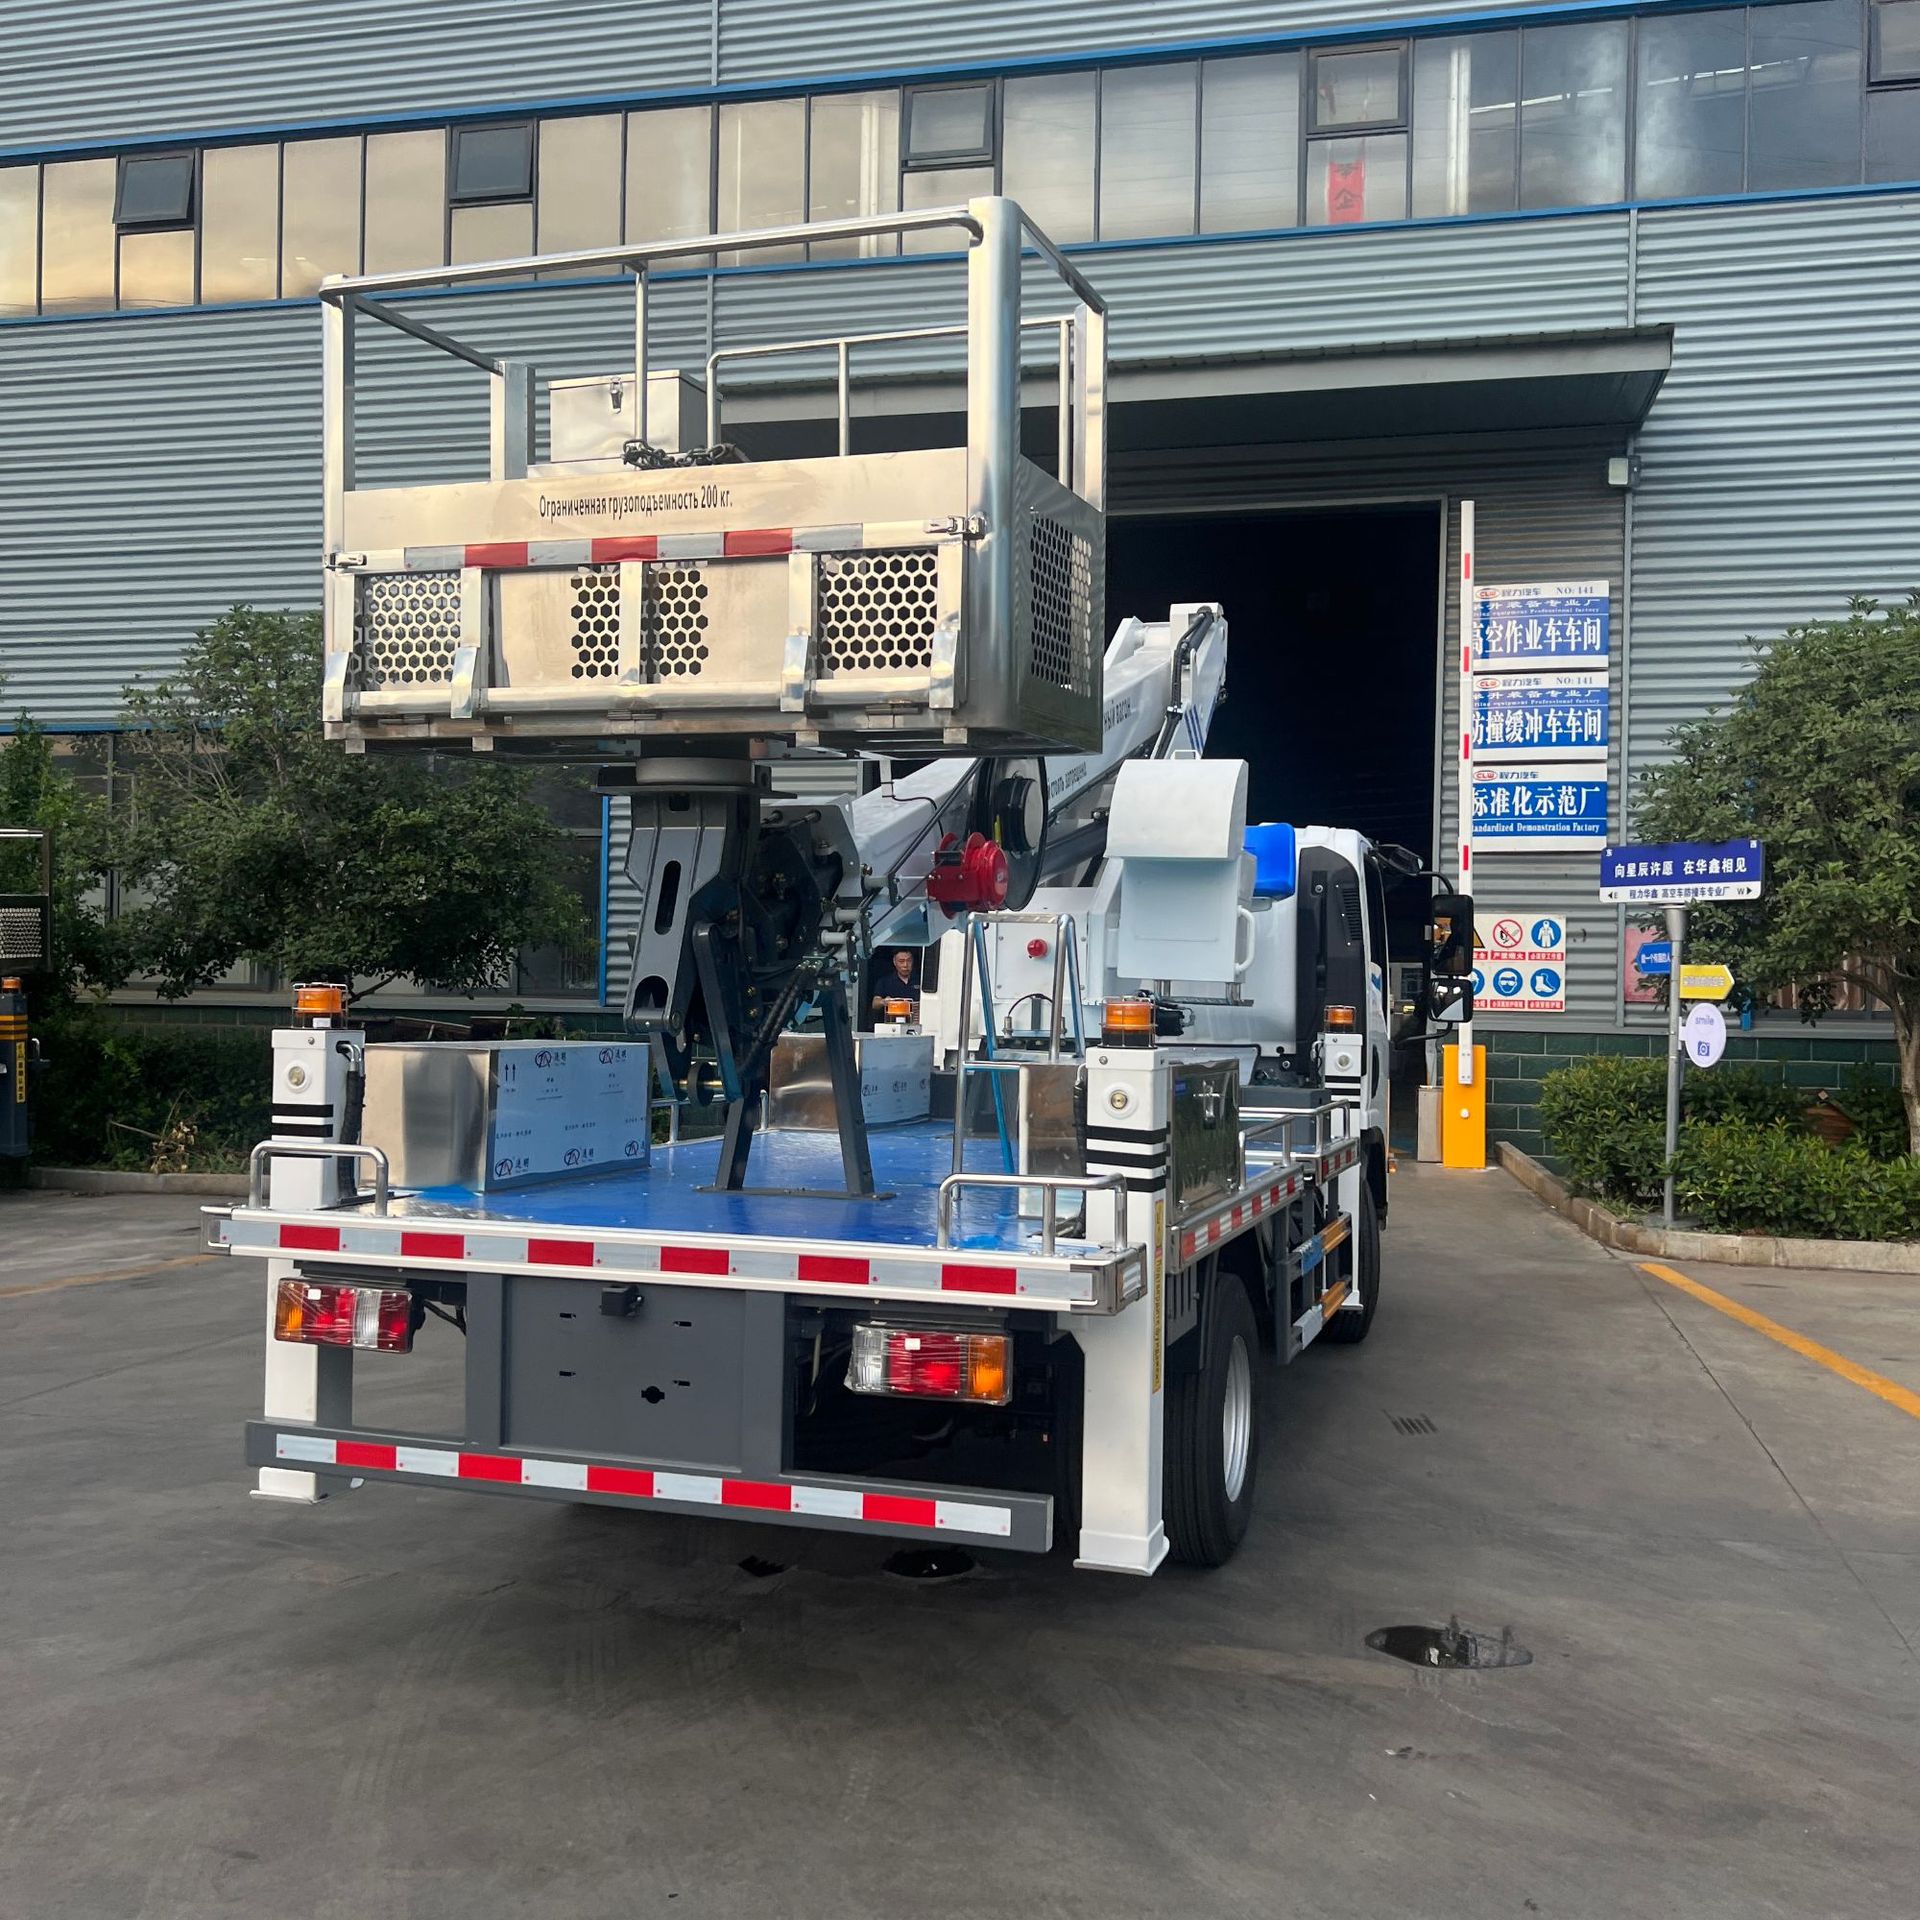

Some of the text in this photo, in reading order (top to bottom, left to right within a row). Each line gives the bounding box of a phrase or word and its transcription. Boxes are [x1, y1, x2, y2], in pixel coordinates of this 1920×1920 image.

[539, 484, 733, 523] Ограниченная грузоподъемность 200 кг.
[1472, 822, 1600, 833] tandardized Demonstration Factory
[1614, 857, 1747, 878] 向星辰许愿 在华鑫相见
[1695, 1015, 1714, 1026] smile
